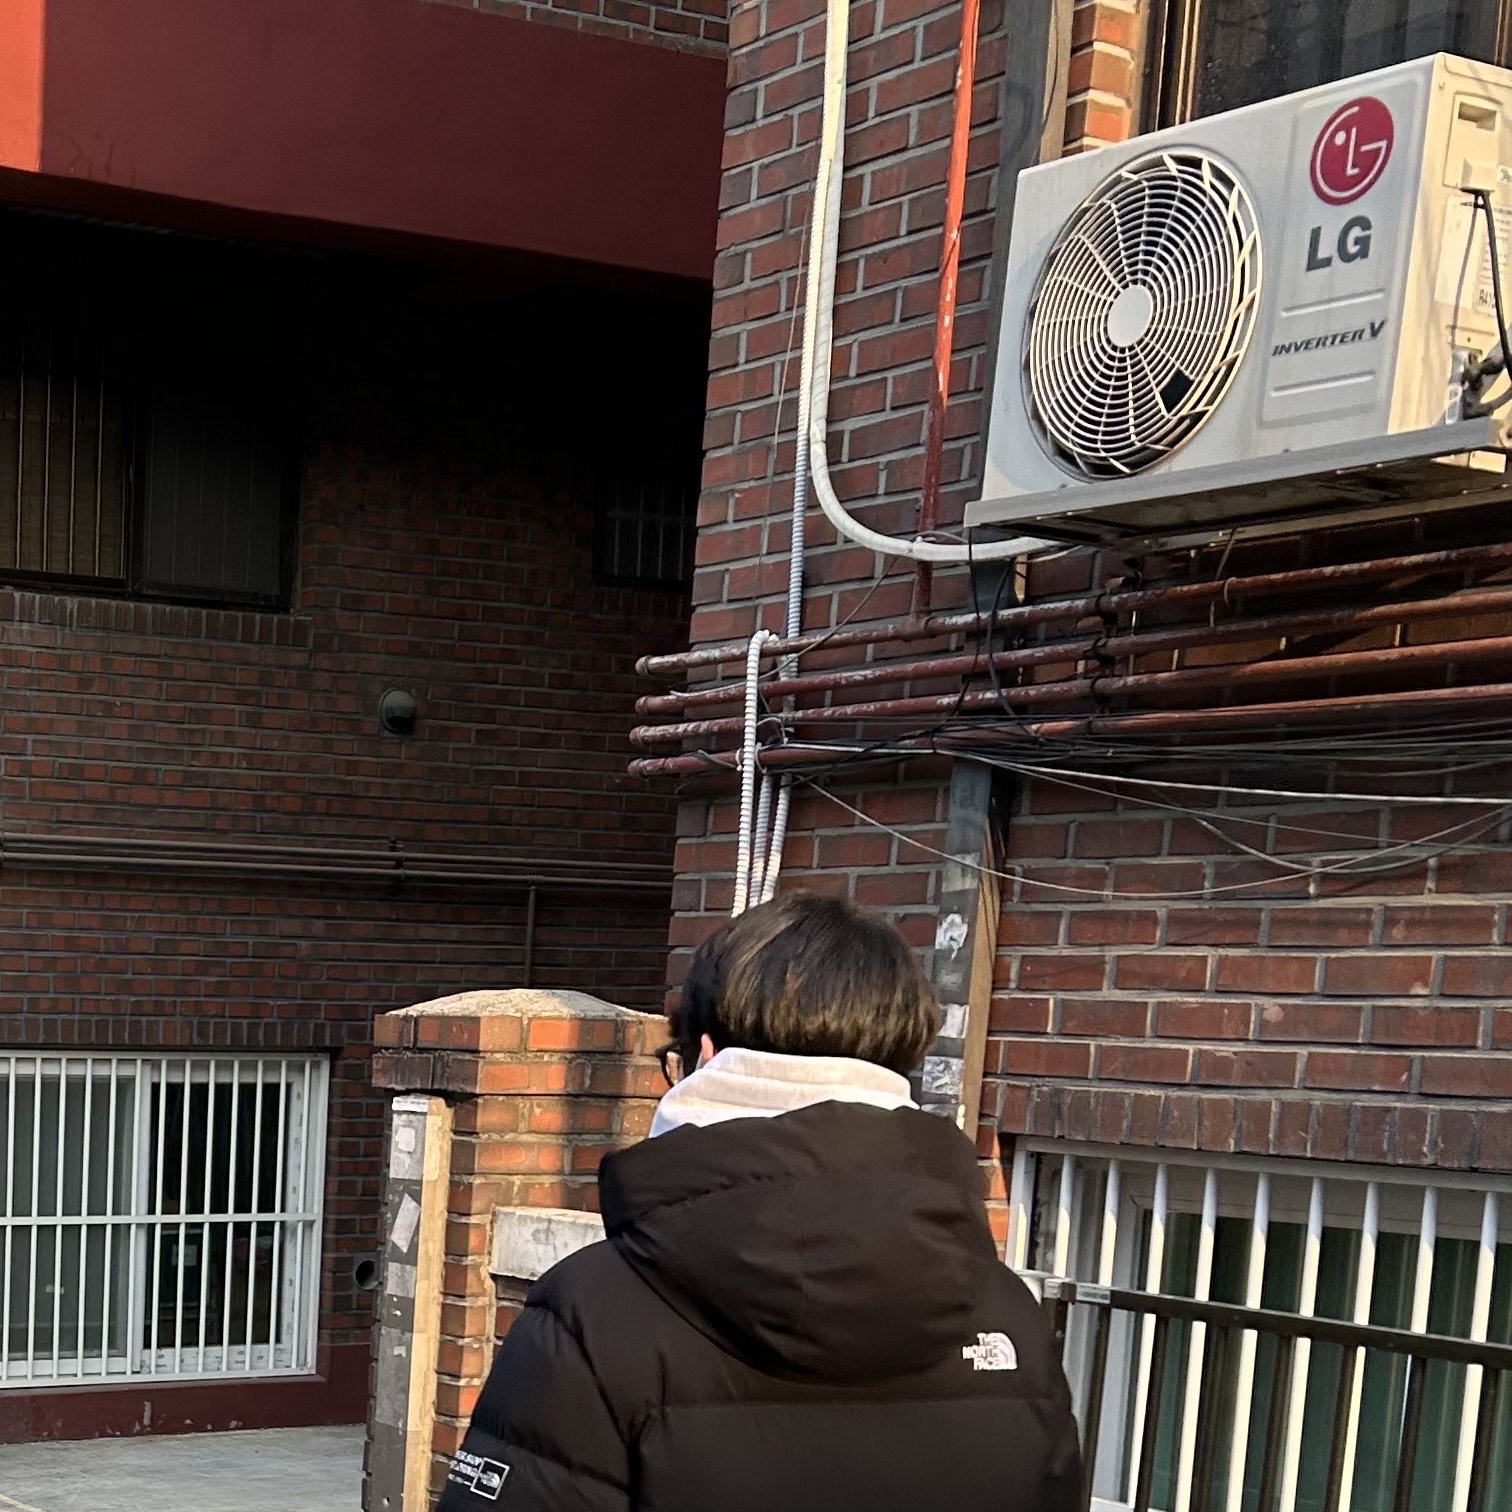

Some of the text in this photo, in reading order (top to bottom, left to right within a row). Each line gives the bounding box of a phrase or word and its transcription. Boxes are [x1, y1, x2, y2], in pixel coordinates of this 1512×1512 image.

[1305, 214, 1373, 272] LG
[1271, 319, 1388, 357] INVERTER V
